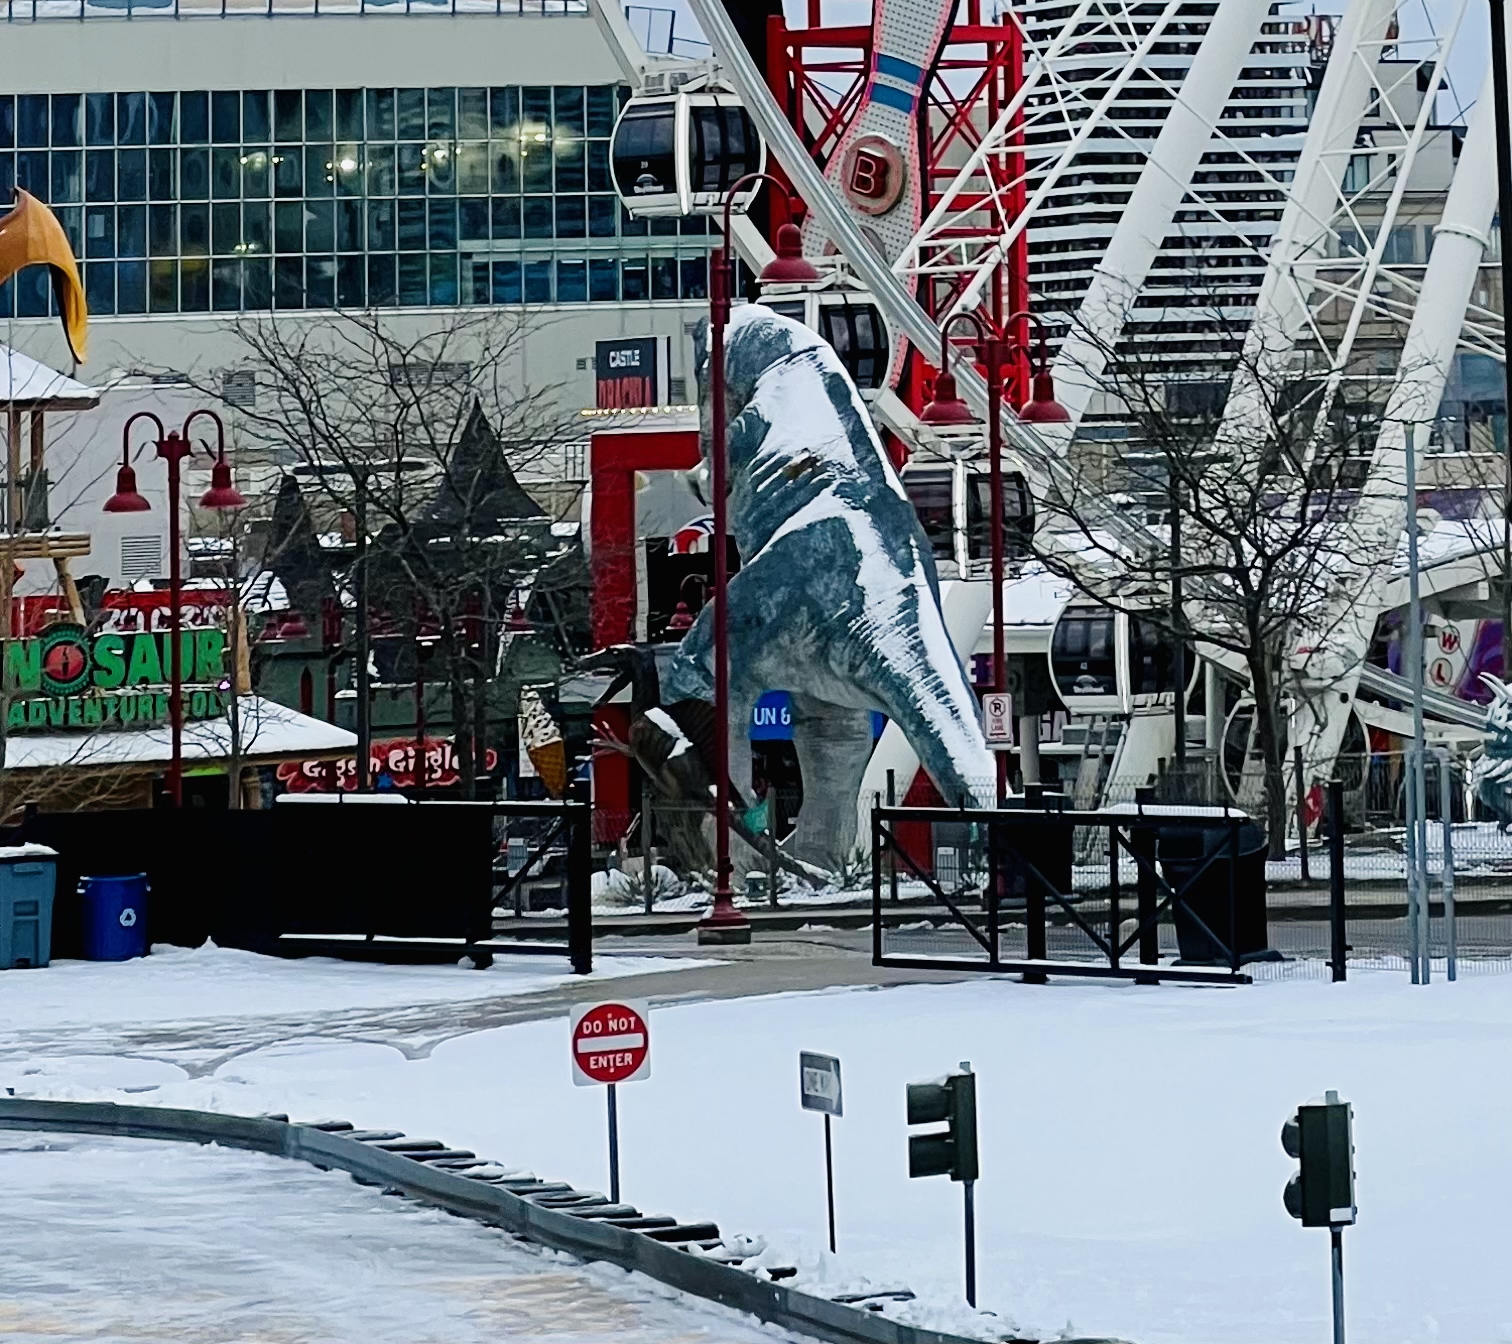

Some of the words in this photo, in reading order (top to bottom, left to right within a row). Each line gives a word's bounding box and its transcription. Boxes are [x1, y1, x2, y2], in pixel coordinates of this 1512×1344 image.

[609, 349, 641, 368] CASTLE
[7, 693, 169, 728] ADVENTURE
[780, 706, 791, 725] &
[582, 1020, 603, 1035] DO
[608, 1016, 636, 1032] NOT
[589, 1053, 633, 1070] ENTER
